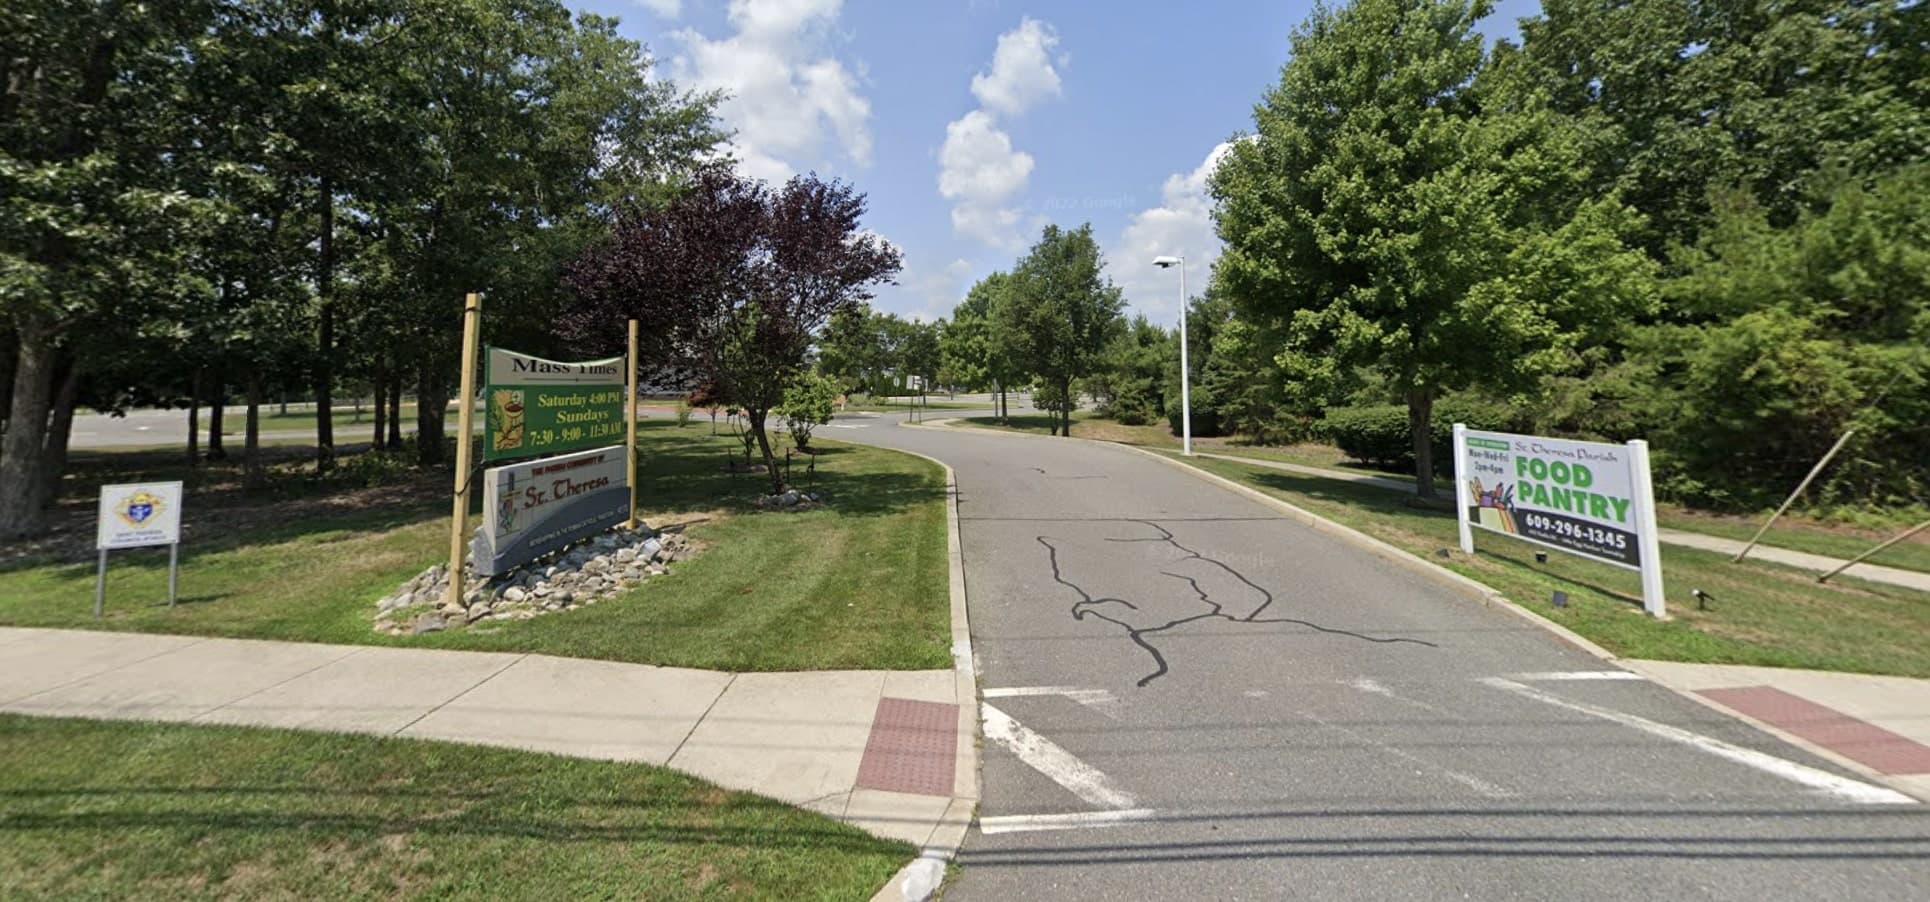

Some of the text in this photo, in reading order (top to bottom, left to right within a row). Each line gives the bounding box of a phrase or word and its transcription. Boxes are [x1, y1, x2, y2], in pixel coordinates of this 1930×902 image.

[512, 358, 571, 374] Mass
[538, 391, 620, 408] Saturday 4:00 PM
[556, 409, 609, 425] Sundays
[530, 429, 553, 447] 7:30
[561, 427, 582, 442] 9:00
[590, 424, 609, 438] 11:30
[609, 421, 621, 434] AM
[1531, 443, 1575, 459] Theresa
[1577, 448, 1618, 463] Parish
[1516, 455, 1593, 488] FOOD
[553, 476, 609, 500] Theresa
[1517, 479, 1631, 523] PANTRY
[1525, 513, 1627, 550] 609-296-1345
